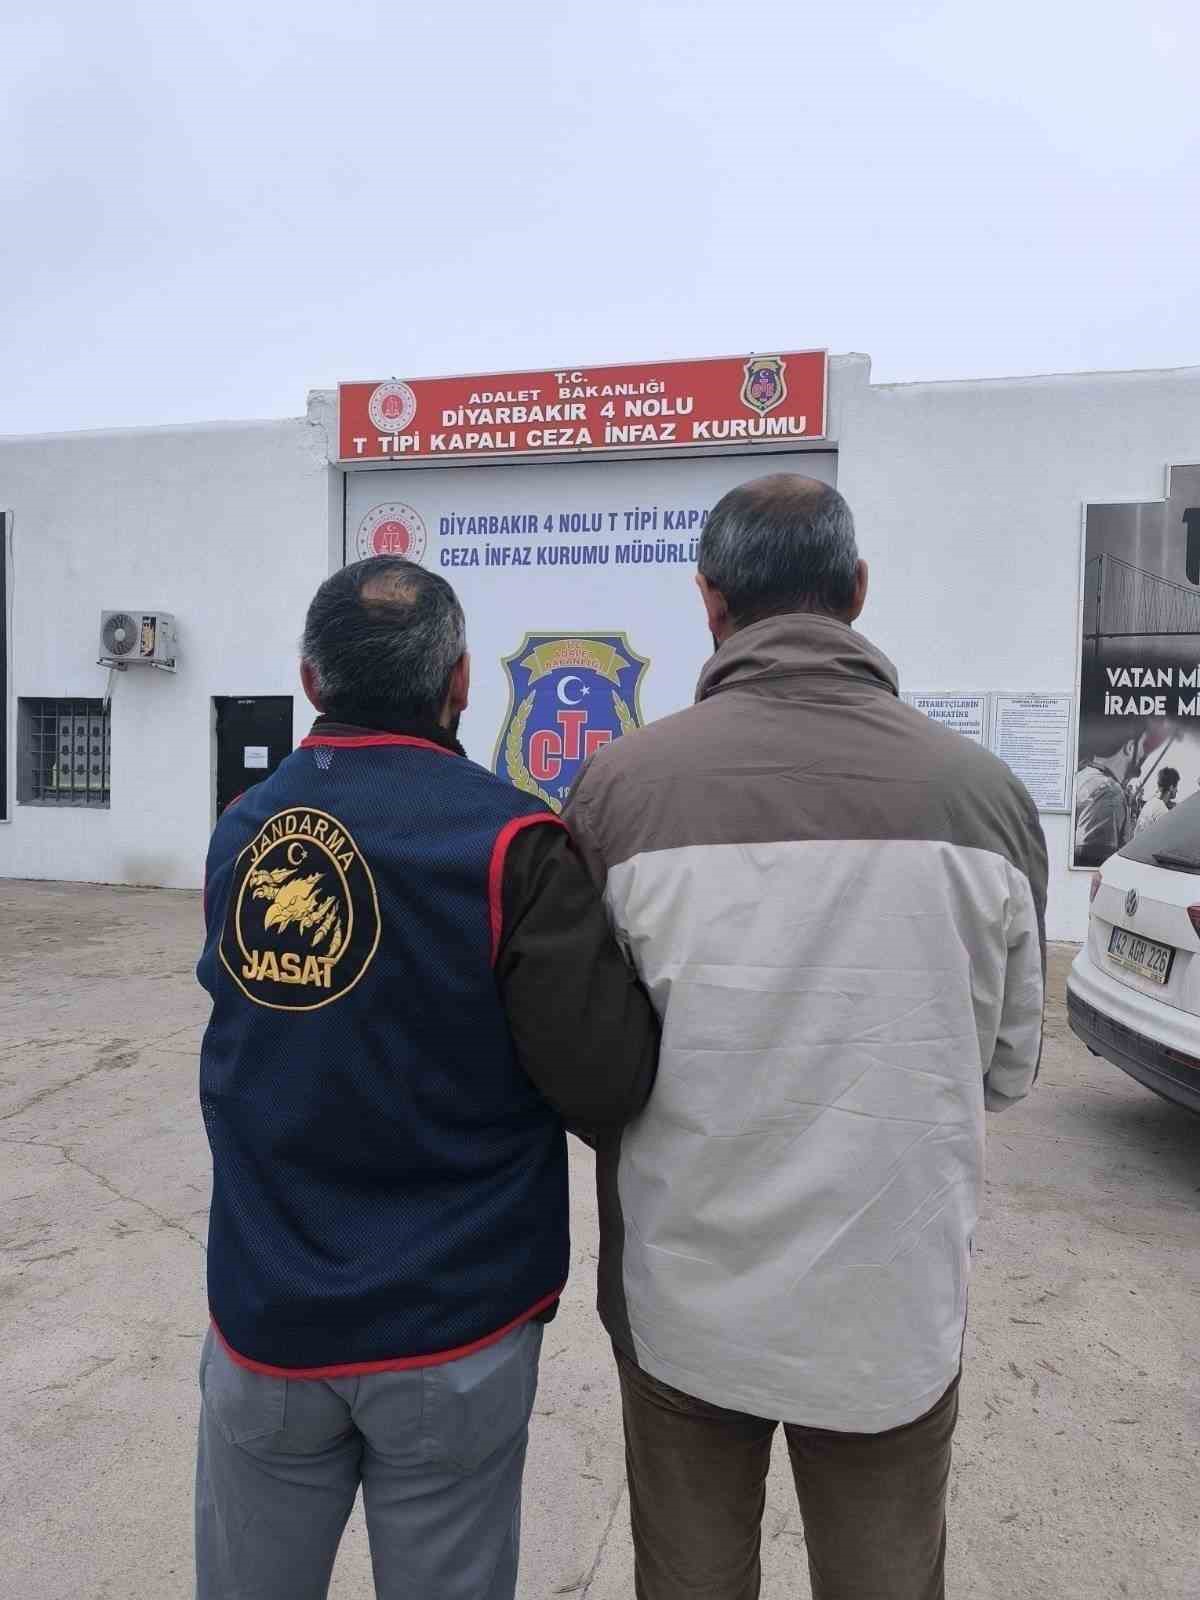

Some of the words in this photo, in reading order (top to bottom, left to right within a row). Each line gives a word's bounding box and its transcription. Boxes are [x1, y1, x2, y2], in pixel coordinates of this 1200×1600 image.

[468, 389, 541, 405] ADALET
[559, 379, 665, 400] BAKANLIĞI
[555, 372, 588, 385] T.C.
[442, 403, 587, 427] DİYARBAKIR
[600, 401, 615, 419] 4
[625, 397, 694, 417] NOLU
[353, 437, 367, 454] T
[378, 431, 420, 453] TİPİ
[430, 431, 516, 451] KAPALI
[526, 427, 593, 447] CEZA
[605, 421, 677, 444] İNFAZ
[693, 415, 806, 439] KURUMU
[439, 512, 538, 536] DİYARBAKIR
[543, 514, 554, 533] 4
[559, 512, 602, 533] NOLU
[608, 512, 618, 532] T
[624, 506, 658, 531] TİPİ
[440, 547, 480, 567] CEZA
[485, 543, 532, 566] İNFAZ
[537, 545, 609, 566] KURUMU
[1106, 667, 1173, 689] VATAN
[1104, 690, 1167, 716] İRADE
[250, 814, 356, 873] JANDARMA
[1114, 933, 1128, 955] 42
[1147, 947, 1168, 972] 226
[242, 949, 338, 988] JASAT
